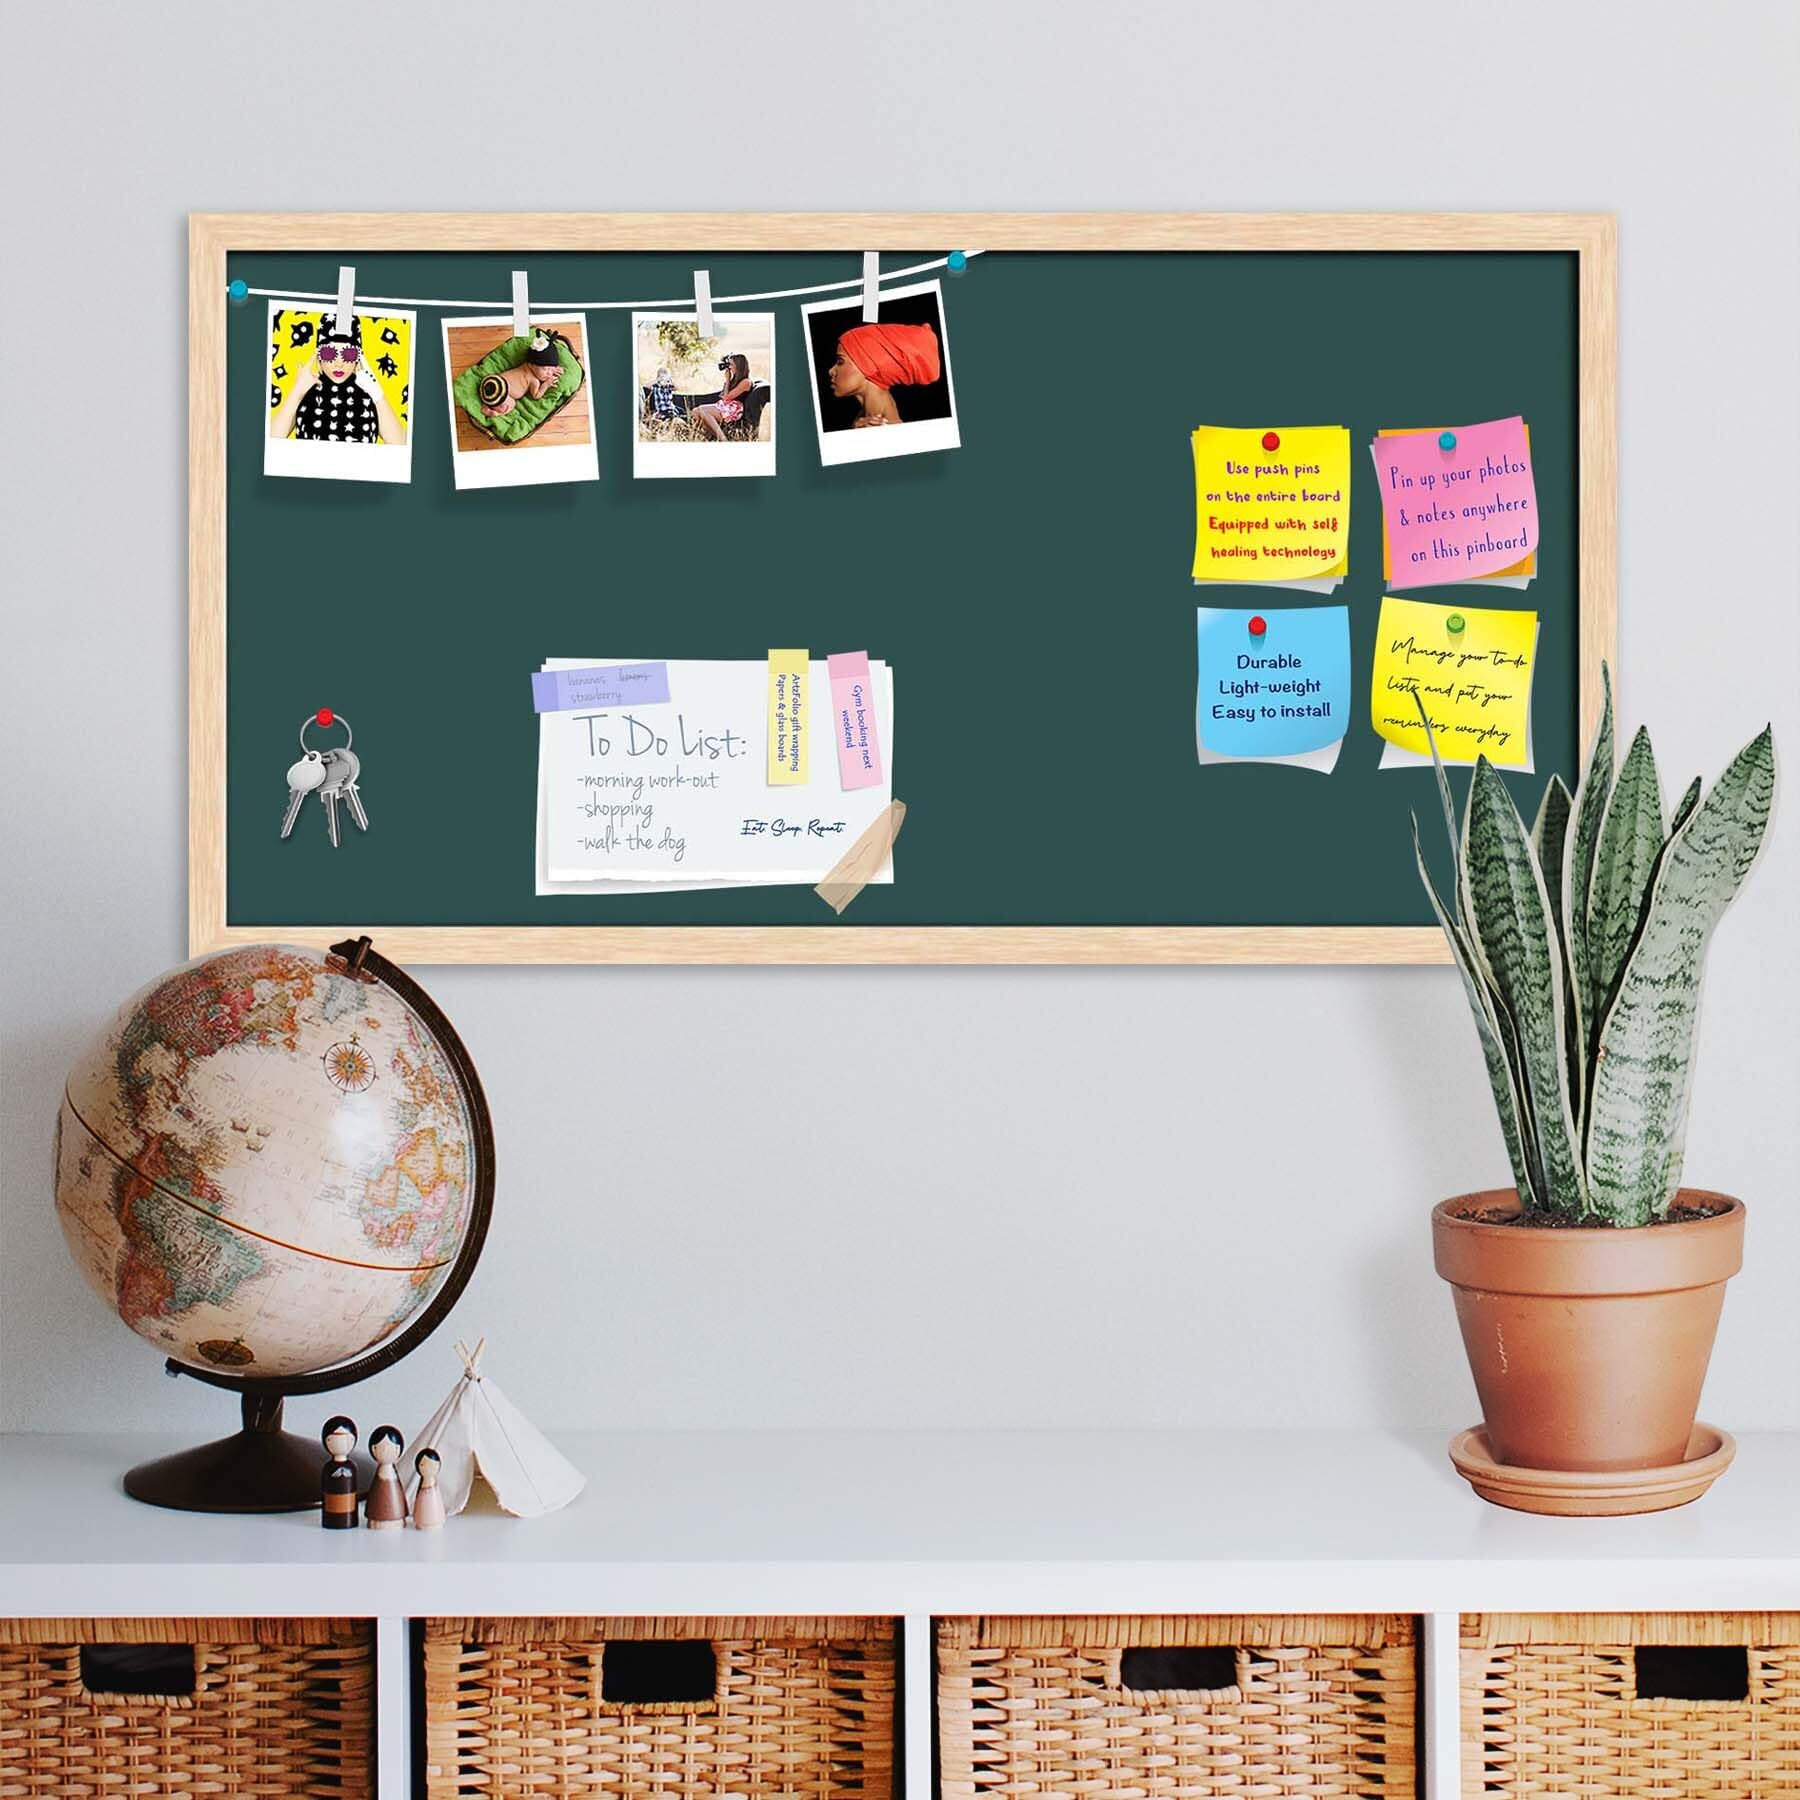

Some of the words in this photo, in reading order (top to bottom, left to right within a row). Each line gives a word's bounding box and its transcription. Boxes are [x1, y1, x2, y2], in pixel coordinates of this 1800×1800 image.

[1226, 461, 1249, 475] Use
[1255, 464, 1288, 478] push
[1295, 464, 1320, 478] pins
[1390, 466, 1413, 489] Pin
[1420, 475, 1435, 490] up
[1442, 469, 1472, 488] your
[1479, 454, 1526, 484] photos
[1206, 493, 1221, 502] on
[1226, 491, 1250, 502] the
[1256, 491, 1296, 502] entire
[1302, 489, 1341, 502] board
[1400, 508, 1409, 526] &
[1417, 502, 1455, 524] notes
[1463, 493, 1528, 521] anywhere
[1209, 516, 1269, 534] Equipped
[1275, 517, 1307, 530] with
[1312, 518, 1338, 532] self
[1211, 546, 1258, 560] healing
[1263, 546, 1336, 560] technology
[1411, 550, 1427, 562] on
[1433, 538, 1460, 559] this
[1467, 527, 1528, 560] pinboard
[1237, 654, 1302, 670] Durable
[1391, 636, 1455, 665] Manage
[1457, 653, 1488, 668] your
[776, 674, 786, 700] Papers
[792, 673, 802, 715] ArtzFolio
[852, 684, 863, 707] Gym
[1219, 678, 1321, 698] Light-weight
[1424, 683, 1454, 697] and
[1455, 685, 1485, 704] put
[1481, 691, 1513, 708] your
[778, 702, 786, 710] &
[1212, 704, 1255, 722] Easy
[1260, 705, 1276, 718] to
[1281, 702, 1331, 718] install
[776, 713, 787, 732] glass
[790, 716, 802, 732] gift
[842, 709, 856, 749] weekend
[857, 709, 868, 747] booking
[572, 714, 610, 757] To
[622, 714, 668, 757] Do
[678, 714, 747, 760] List:
[1455, 724, 1512, 746] everyday
[777, 734, 787, 762] boards
[790, 734, 799, 772] wrapping
[862, 749, 872, 770] next
[649, 764, 720, 788] work-out
[626, 824, 654, 851] the
[658, 826, 687, 862] dog
